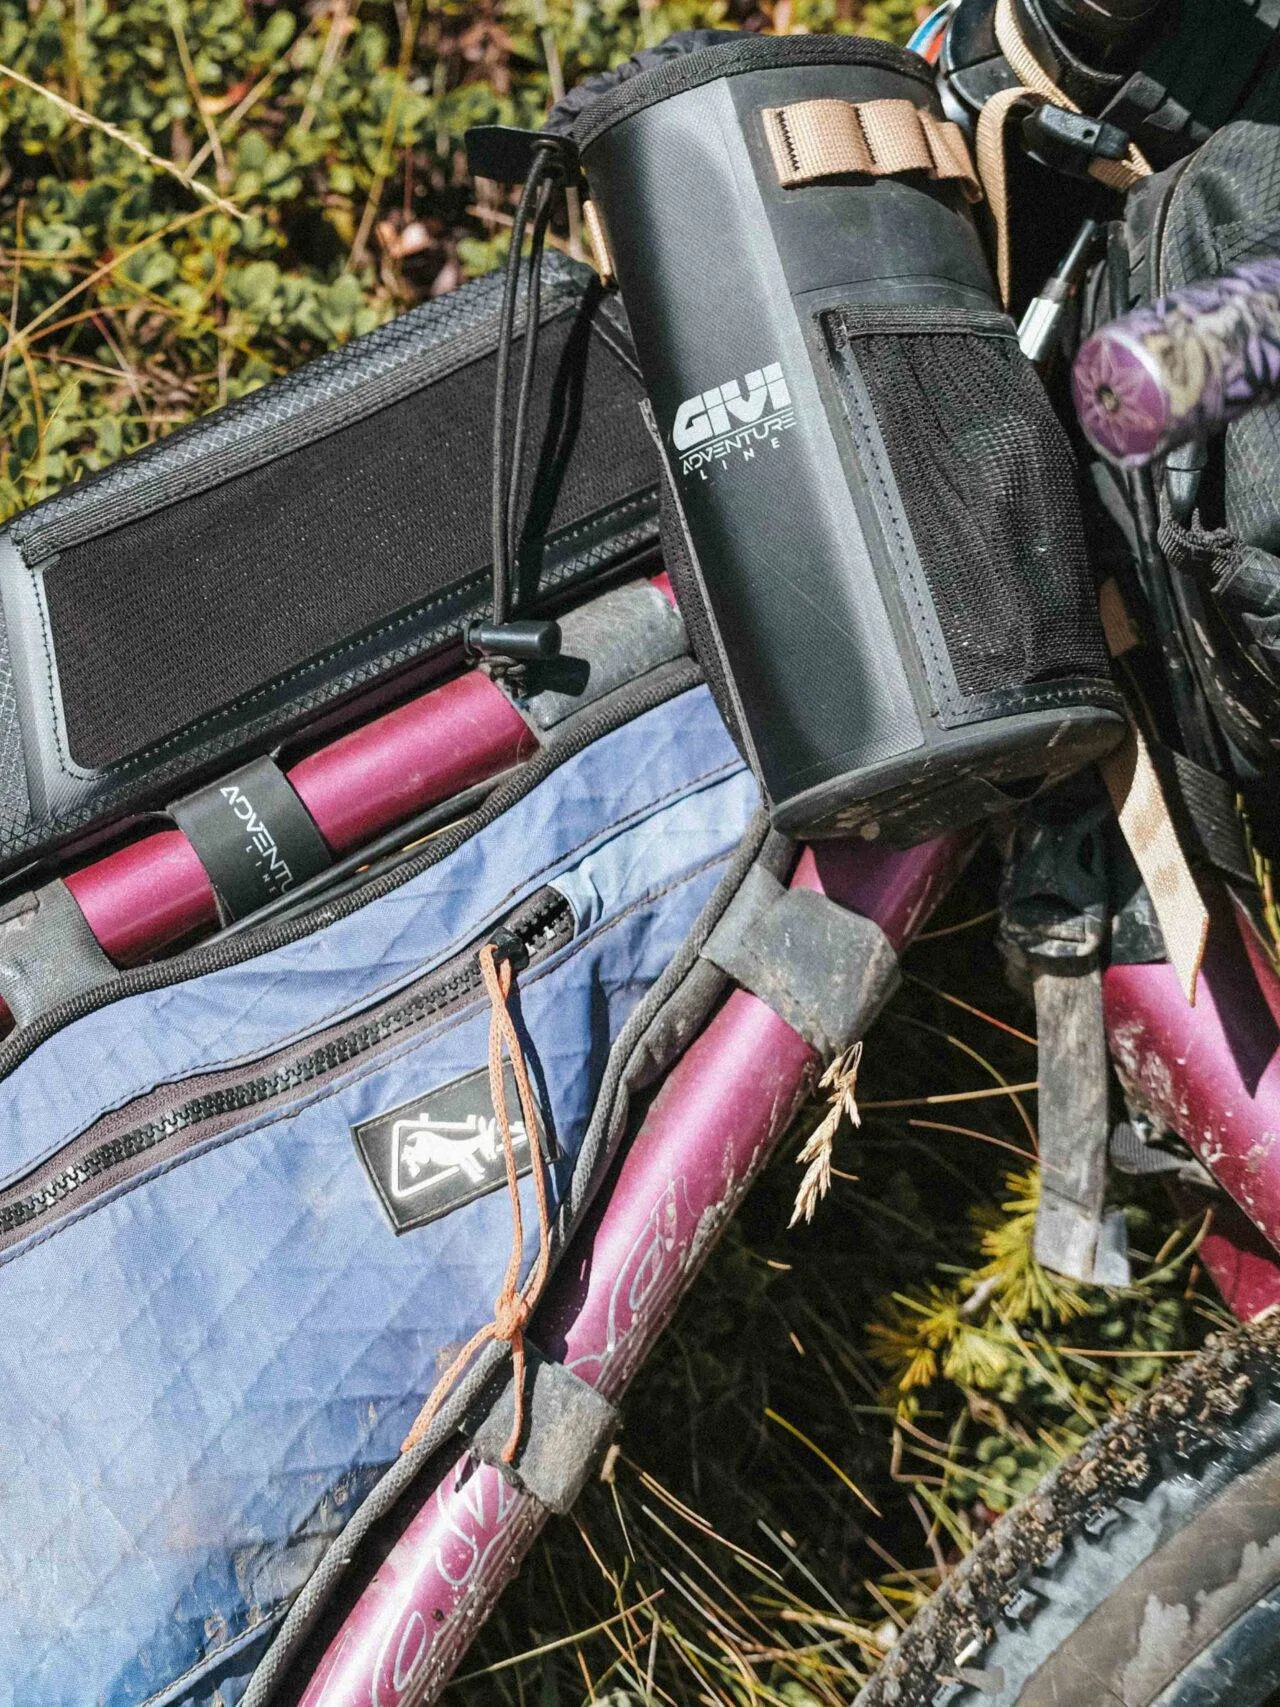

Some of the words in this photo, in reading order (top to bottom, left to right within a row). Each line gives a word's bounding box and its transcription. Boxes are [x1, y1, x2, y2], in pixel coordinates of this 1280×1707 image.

[673, 362, 792, 451] GIVI
[682, 410, 797, 476] ADVENTURE
[699, 436, 781, 481] LINE
[220, 786, 294, 893] ADVENTU
